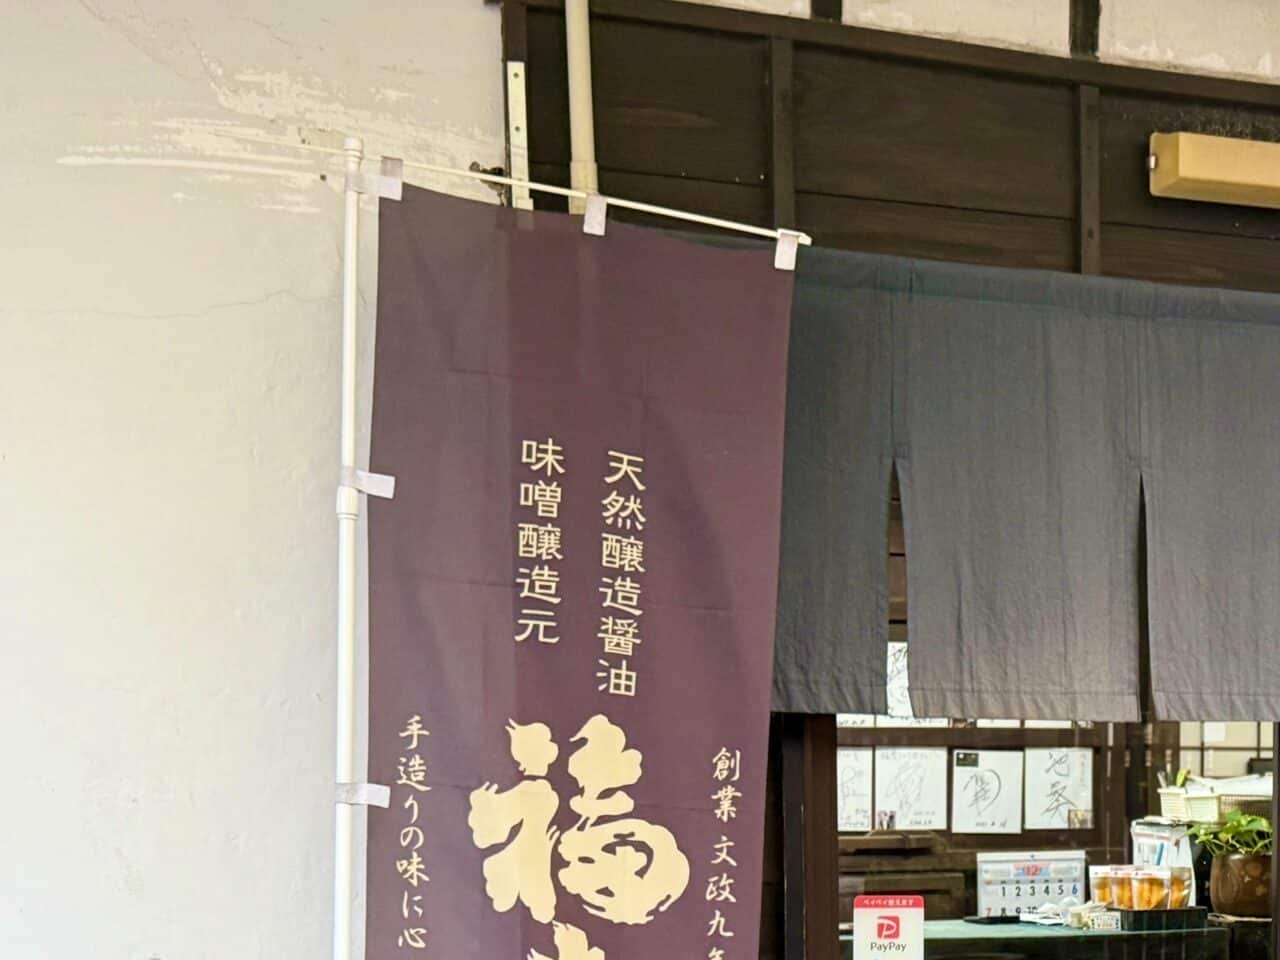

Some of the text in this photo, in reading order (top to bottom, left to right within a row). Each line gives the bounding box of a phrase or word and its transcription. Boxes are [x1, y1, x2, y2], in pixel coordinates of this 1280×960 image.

[514, 437, 566, 643] 味噌醸造元
[596, 450, 647, 696] 天然醸造醤油
[1001, 884, 1078, 897] 1 2 3 4 5 6
[985, 907, 992, 917] 7
[870, 942, 907, 953] PayPay
